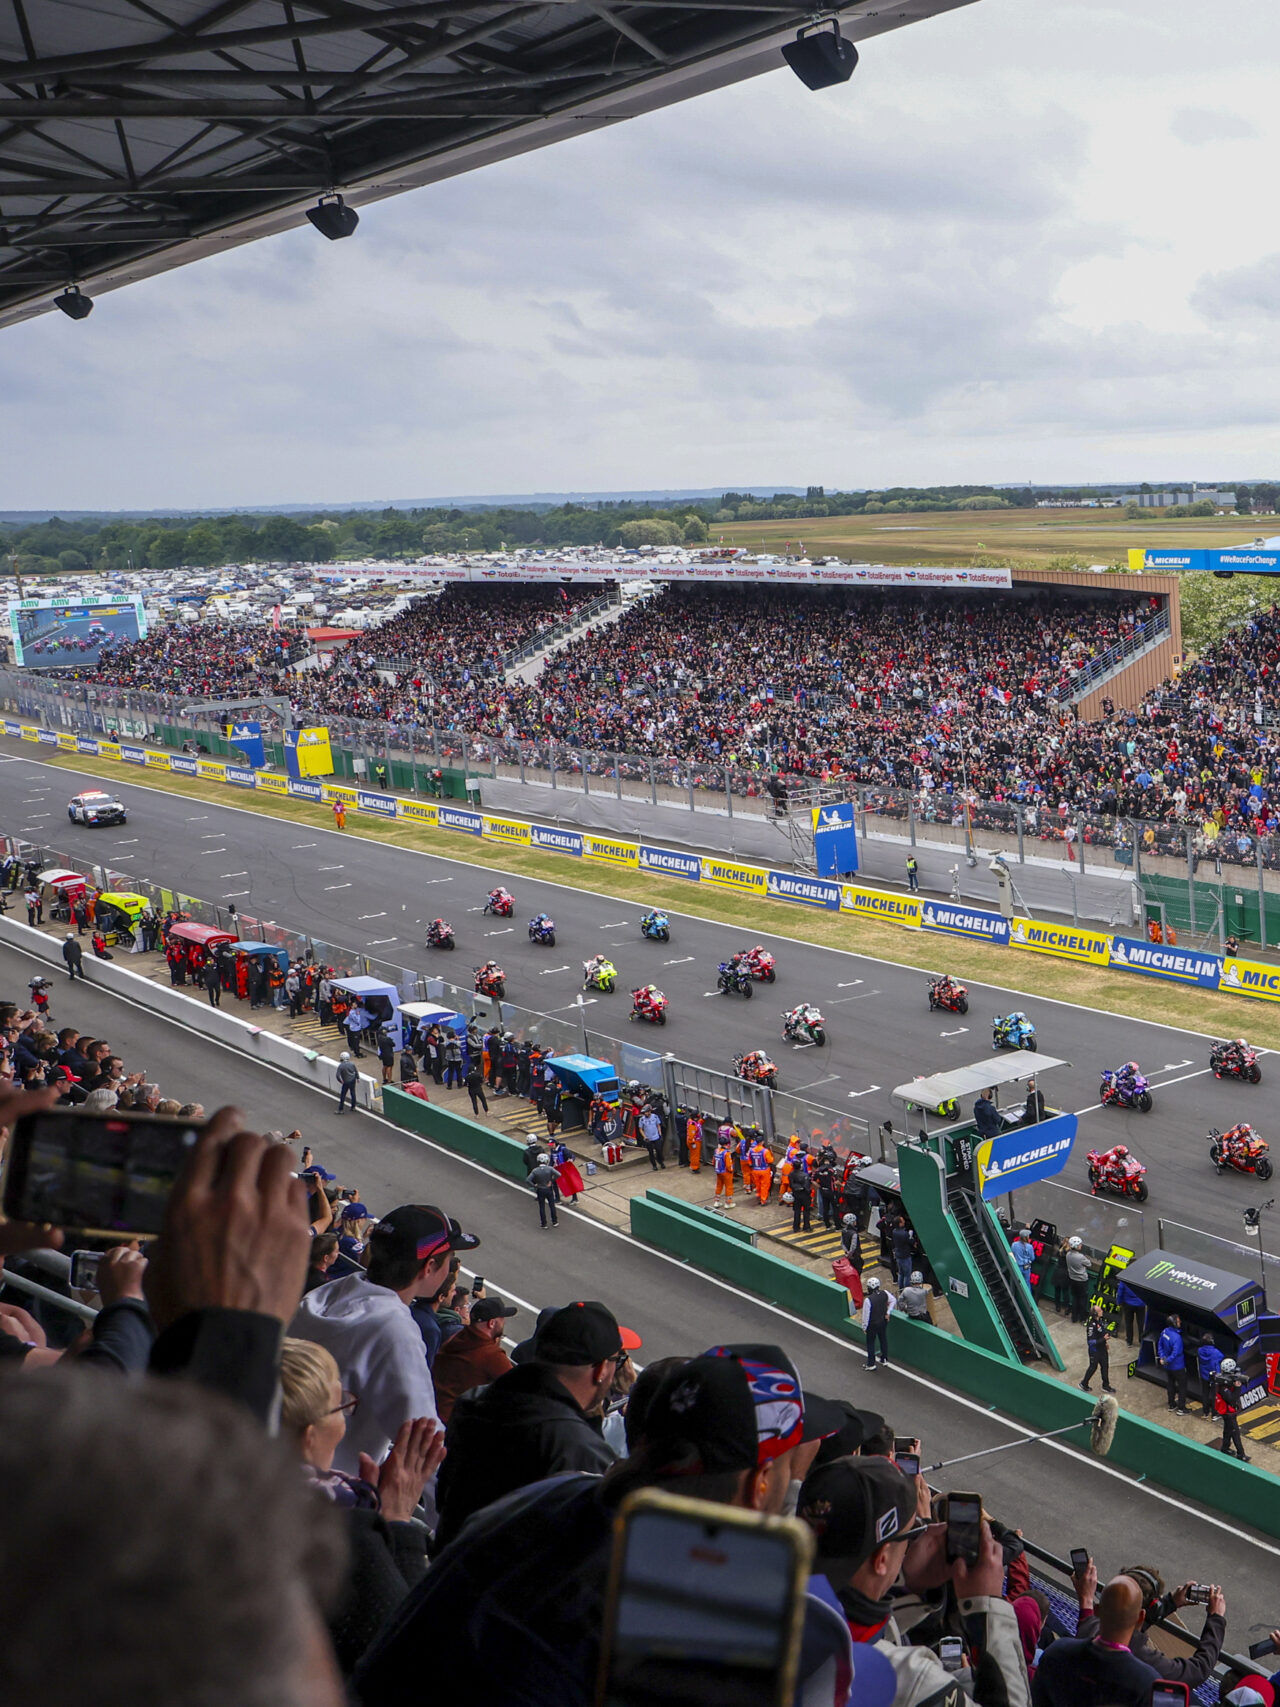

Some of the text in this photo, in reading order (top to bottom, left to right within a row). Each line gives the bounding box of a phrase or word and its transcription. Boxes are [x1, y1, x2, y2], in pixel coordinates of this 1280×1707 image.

[1155, 556, 1190, 564] MICHELIN
[1220, 554, 1277, 566] #WeRaceForChange
[867, 571, 902, 581] TotalEnergies
[917, 572, 953, 582] TotalEnergies
[969, 573, 1008, 584] TotalEnergies
[816, 821, 853, 834] MICHELIN
[363, 797, 395, 812] MICHELIN
[403, 803, 436, 819] MICHELIN
[445, 813, 480, 829] MICHELIN
[490, 821, 529, 839] MICHELIN
[539, 831, 581, 849] MICHELIN
[592, 841, 636, 860] MICHELIN
[648, 853, 699, 873] MICHELIN
[711, 865, 764, 886] MICHELIN
[779, 879, 838, 902] MICHELIN
[854, 893, 919, 918] MICHELIN
[936, 909, 1007, 936] MICHELIN
[1026, 926, 1107, 955] MICHELIN
[1128, 946, 1216, 978] MICHELIN
[1002, 1137, 1072, 1171] MICHELIN
[1167, 1268, 1218, 1290] MONSTER
[1239, 1385, 1267, 1410] ACOSTA
